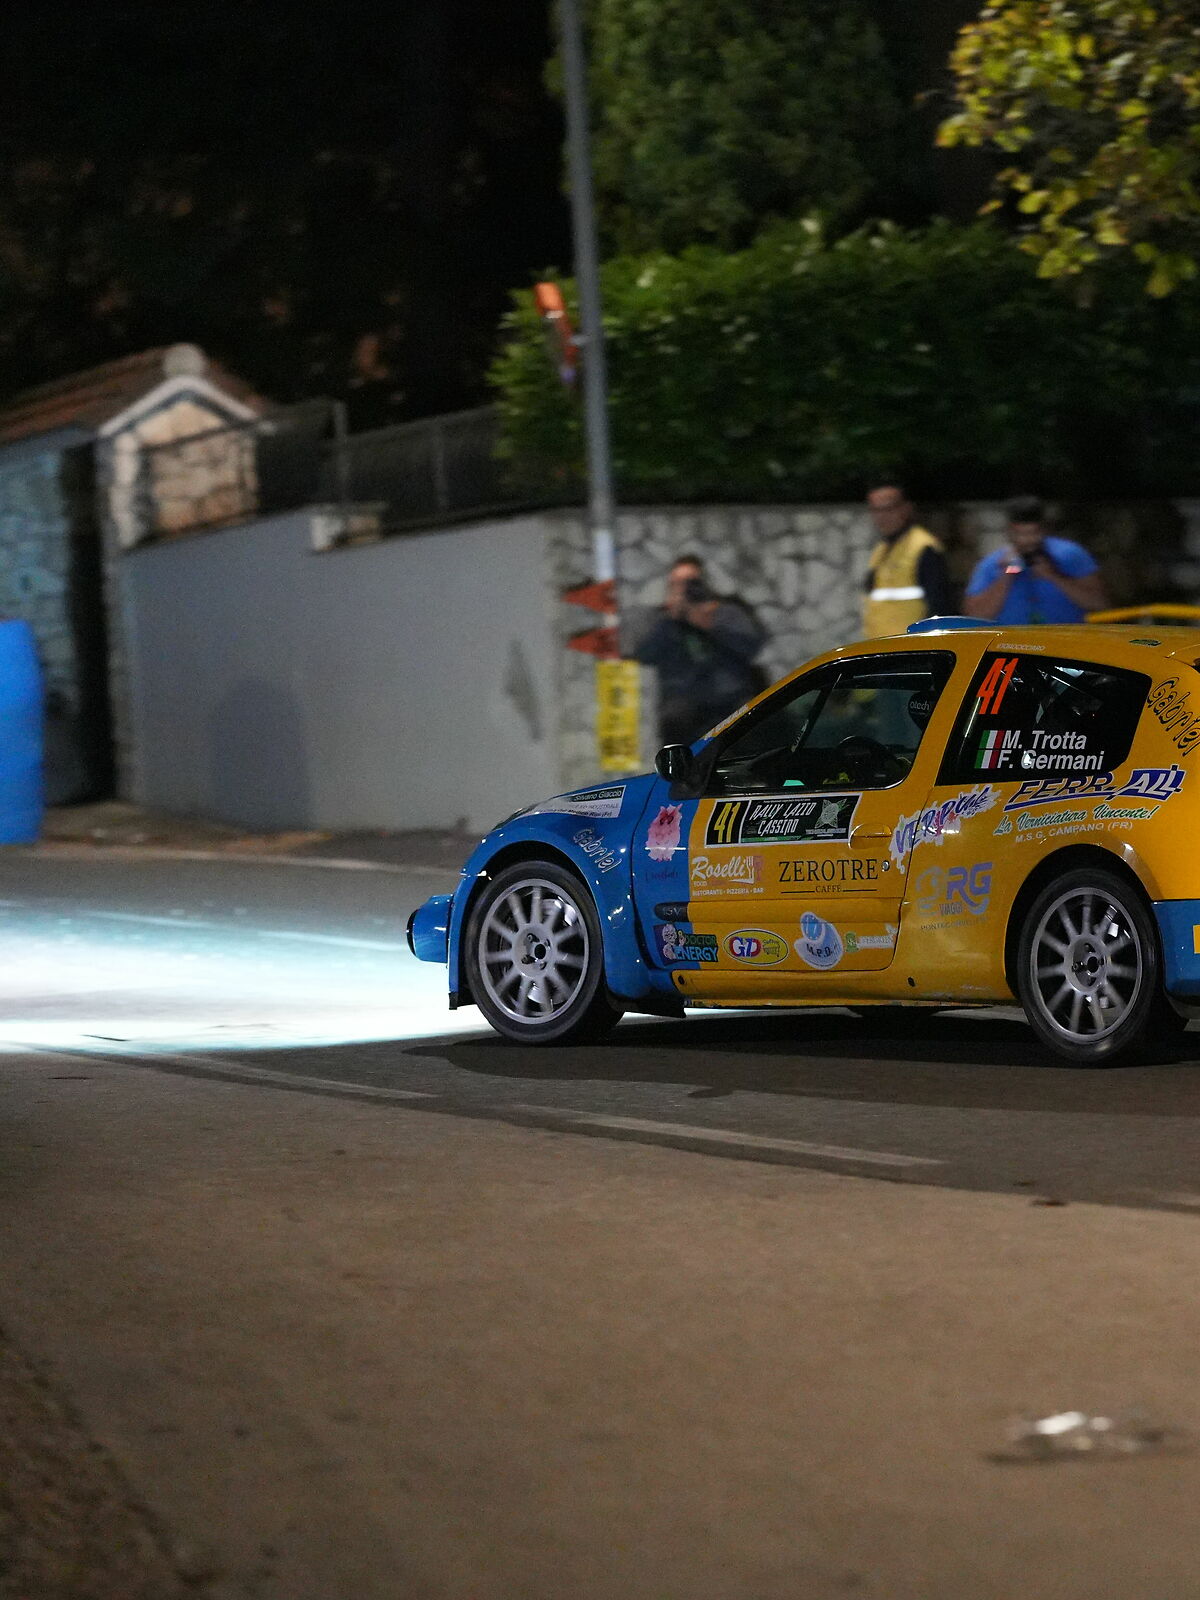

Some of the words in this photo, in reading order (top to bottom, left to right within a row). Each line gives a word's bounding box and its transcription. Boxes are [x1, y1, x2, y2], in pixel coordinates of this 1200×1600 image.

[976, 658, 1019, 714] 41
[1001, 730, 1022, 749] M.
[1031, 730, 1087, 750] Trotta
[997, 750, 1013, 769] F.
[1021, 750, 1105, 770] Germani
[749, 803, 784, 820] RALLY
[993, 816, 1013, 836] La
[1017, 810, 1088, 832] Verniciatura
[1093, 804, 1161, 821] Vincente!
[713, 802, 742, 843] 41
[757, 819, 799, 837] CASSINO
[1050, 823, 1105, 837] CAMPANO
[1107, 821, 1134, 832] (FR)
[691, 856, 746, 881] Roselli
[779, 859, 879, 882] ZEROTRE
[674, 945, 718, 961] ENERGY
